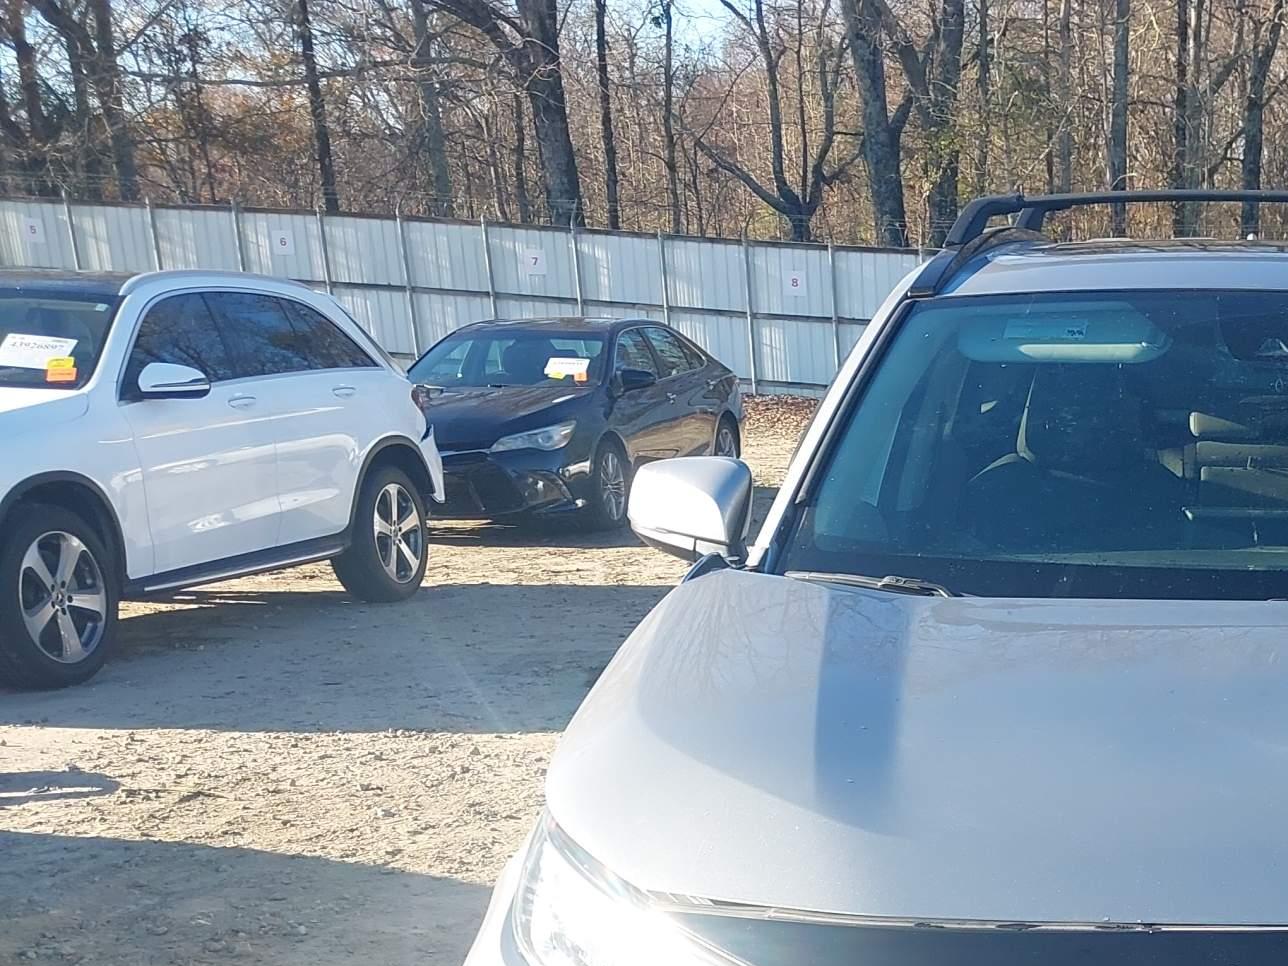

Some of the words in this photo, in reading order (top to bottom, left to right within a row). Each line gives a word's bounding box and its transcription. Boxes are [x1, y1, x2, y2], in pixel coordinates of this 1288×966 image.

[30, 225, 37, 234] 5
[280, 237, 287, 247] 6
[531, 257, 538, 266] 7
[791, 278, 799, 288] 8
